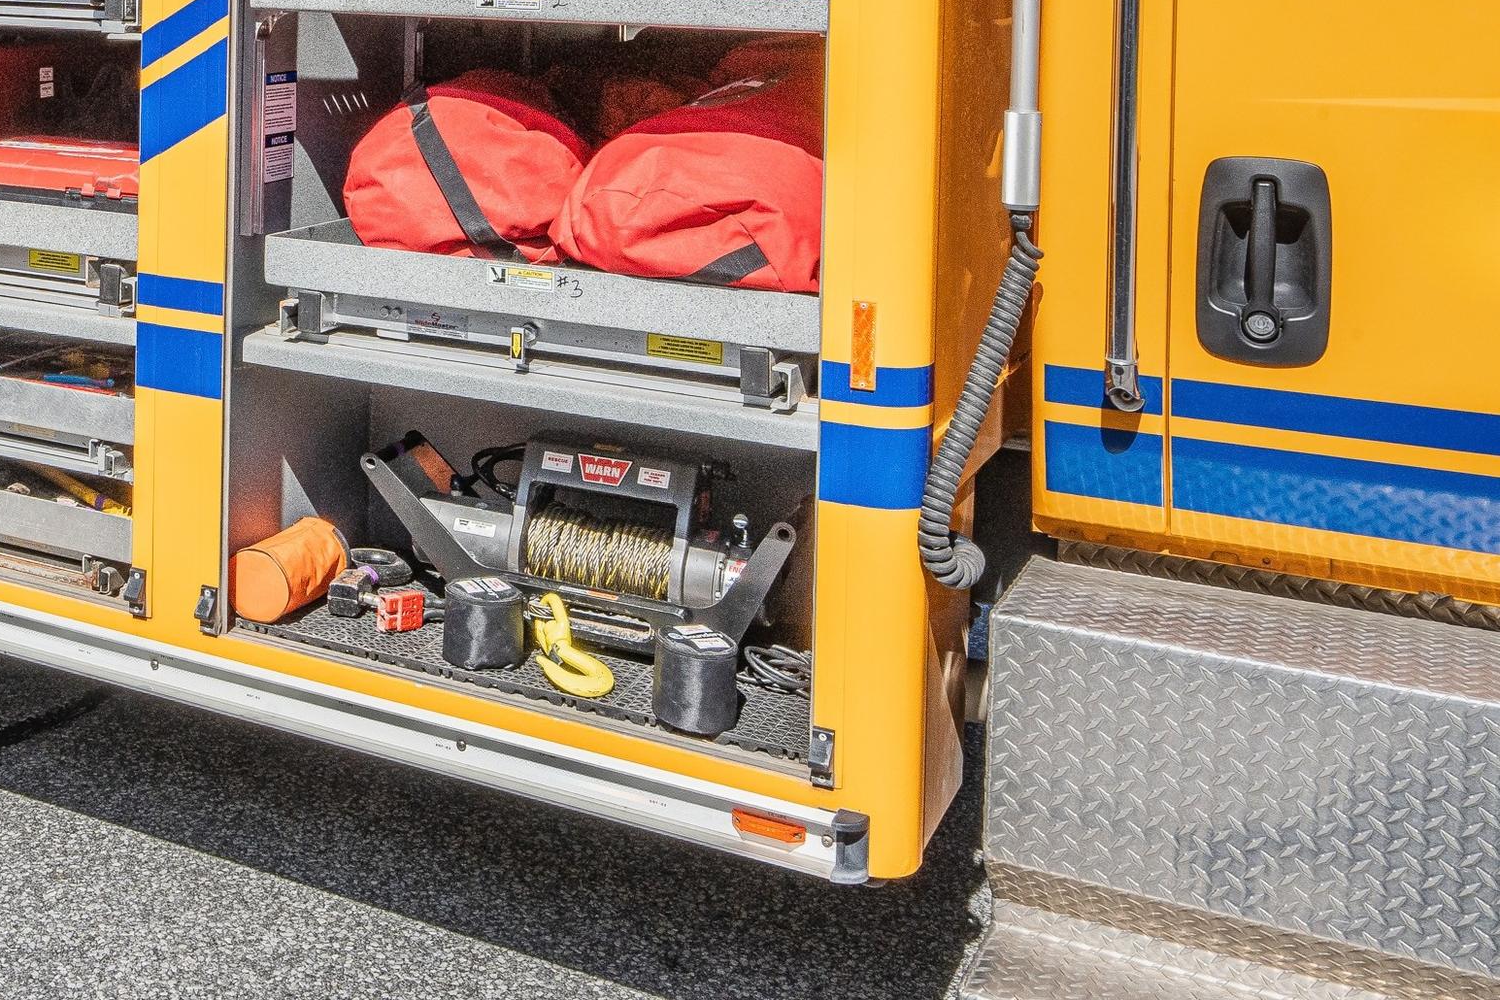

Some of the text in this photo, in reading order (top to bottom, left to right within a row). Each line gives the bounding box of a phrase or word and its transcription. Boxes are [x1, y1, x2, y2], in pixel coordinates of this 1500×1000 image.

[270, 73, 287, 82] NOTICE
[271, 135, 287, 145] NOTICE
[557, 275, 583, 298] #3
[585, 463, 621, 478] WARN
